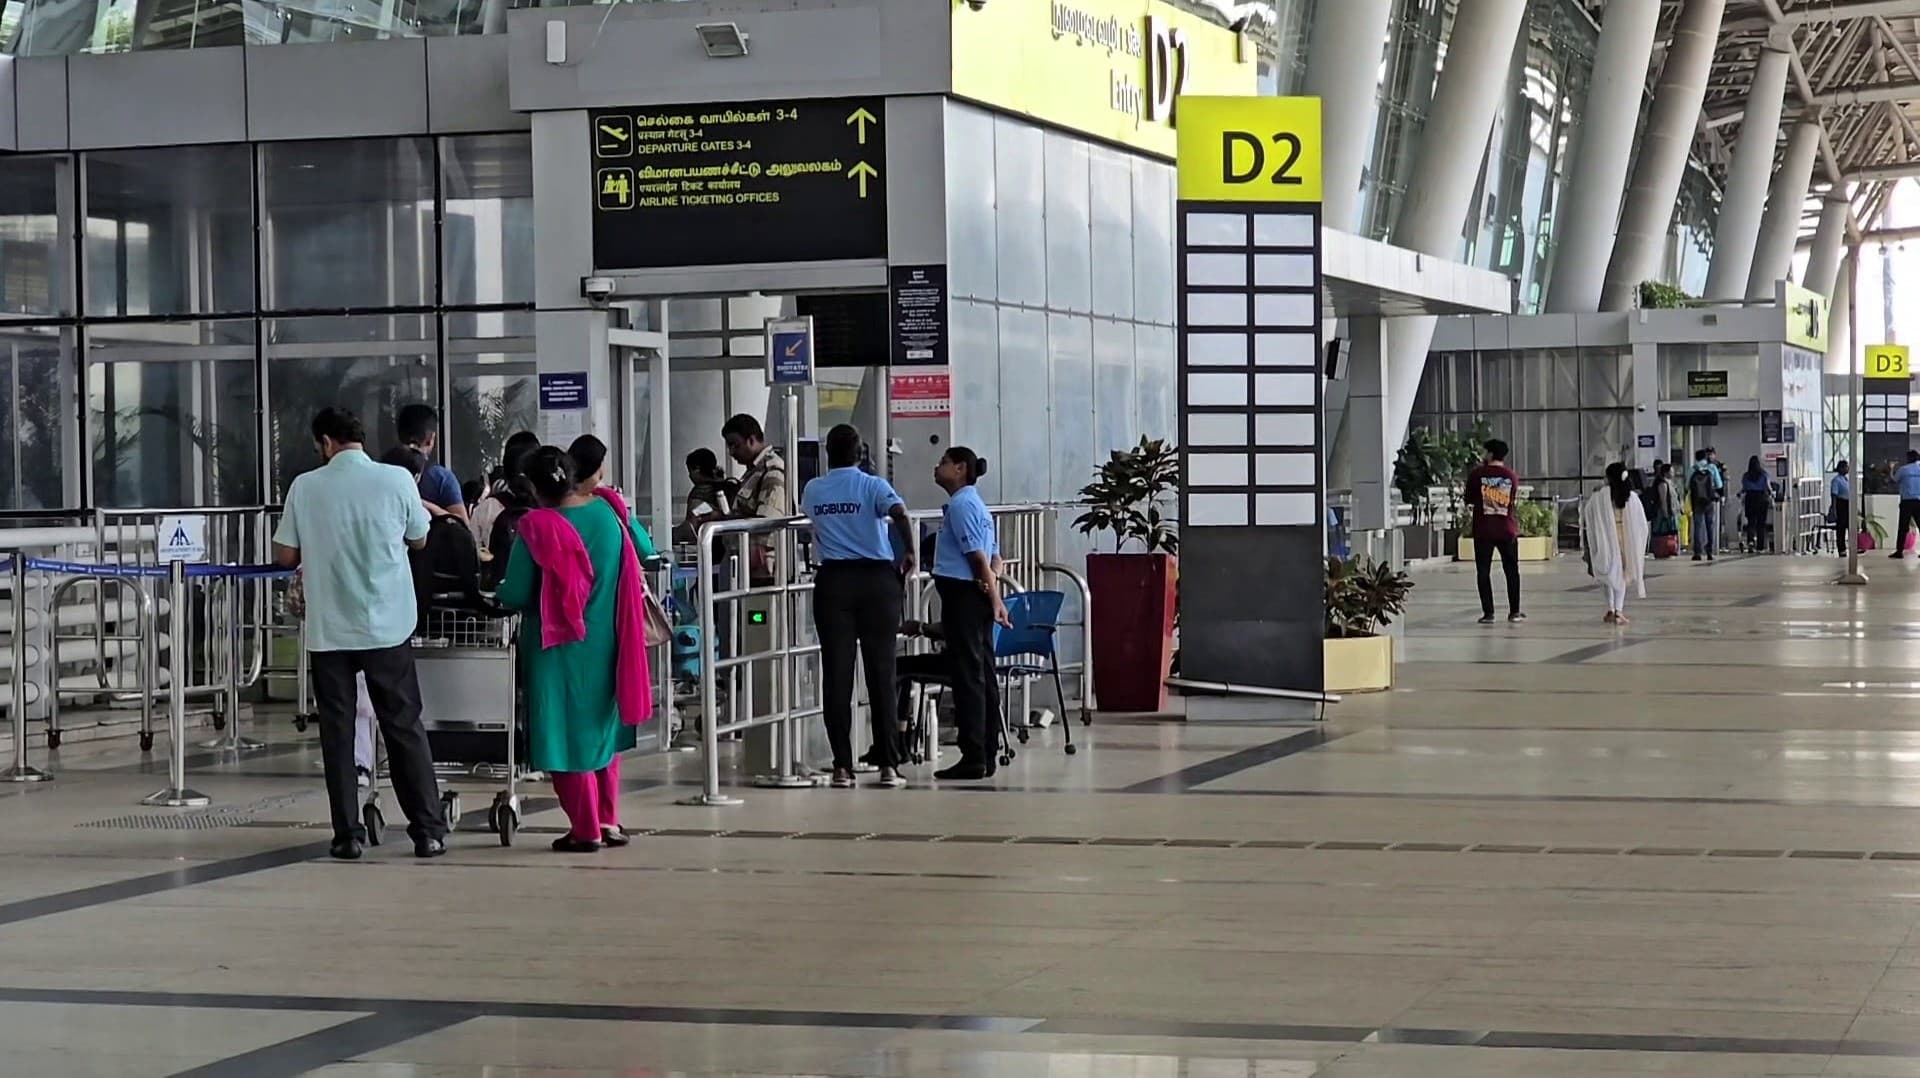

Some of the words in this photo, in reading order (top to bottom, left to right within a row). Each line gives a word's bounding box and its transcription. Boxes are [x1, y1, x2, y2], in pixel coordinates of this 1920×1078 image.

[1145, 15, 1189, 129] D2
[1110, 69, 1143, 131] Entry
[699, 110, 770, 125] வாயில்கள்
[776, 108, 798, 121] 3-4
[689, 129, 703, 138] 3-4
[638, 142, 699, 154] DEPARTURE
[700, 141, 734, 151] GATES
[736, 140, 751, 150] 3-4
[1222, 131, 1302, 184] D2
[765, 158, 842, 176] அலுவலகம்
[639, 194, 678, 207] AIRLINE
[680, 193, 733, 205] TICKETING
[735, 192, 780, 204] OFFICES
[1876, 354, 1903, 372] D3
[814, 503, 861, 516] DIGIBUDDY
